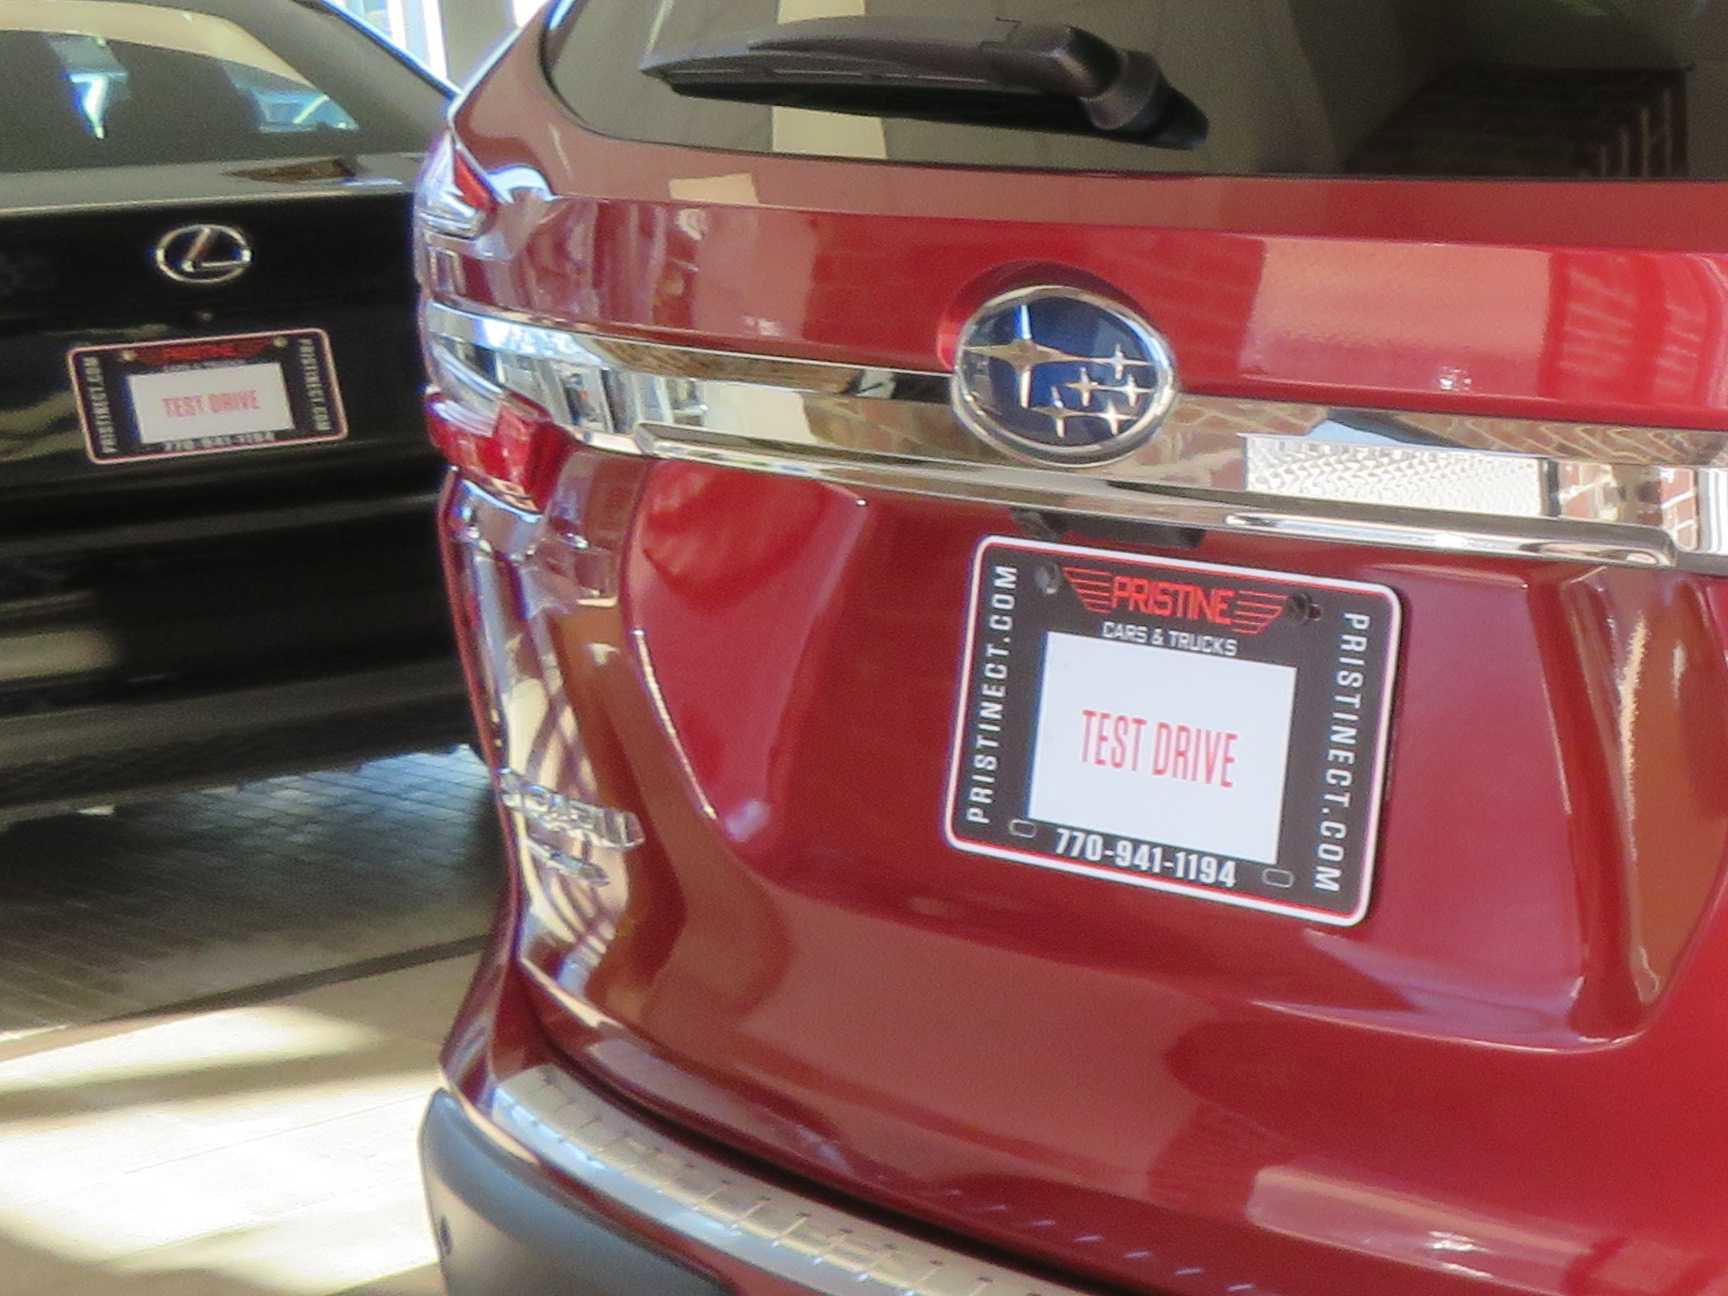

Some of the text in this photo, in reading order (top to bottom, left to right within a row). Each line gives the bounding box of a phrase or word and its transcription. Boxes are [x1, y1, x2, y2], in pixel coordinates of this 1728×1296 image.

[161, 396, 204, 419] TEST
[1112, 575, 1235, 625] PRISTINE
[1102, 622, 1238, 657] CARS & TRUCKS
[967, 565, 1018, 825] PRISTINECT.COM
[1082, 709, 1239, 789] TEST DRIVE
[1312, 612, 1371, 892] PRISTINECT.COM
[1055, 828, 1237, 888] 770-941-1194
